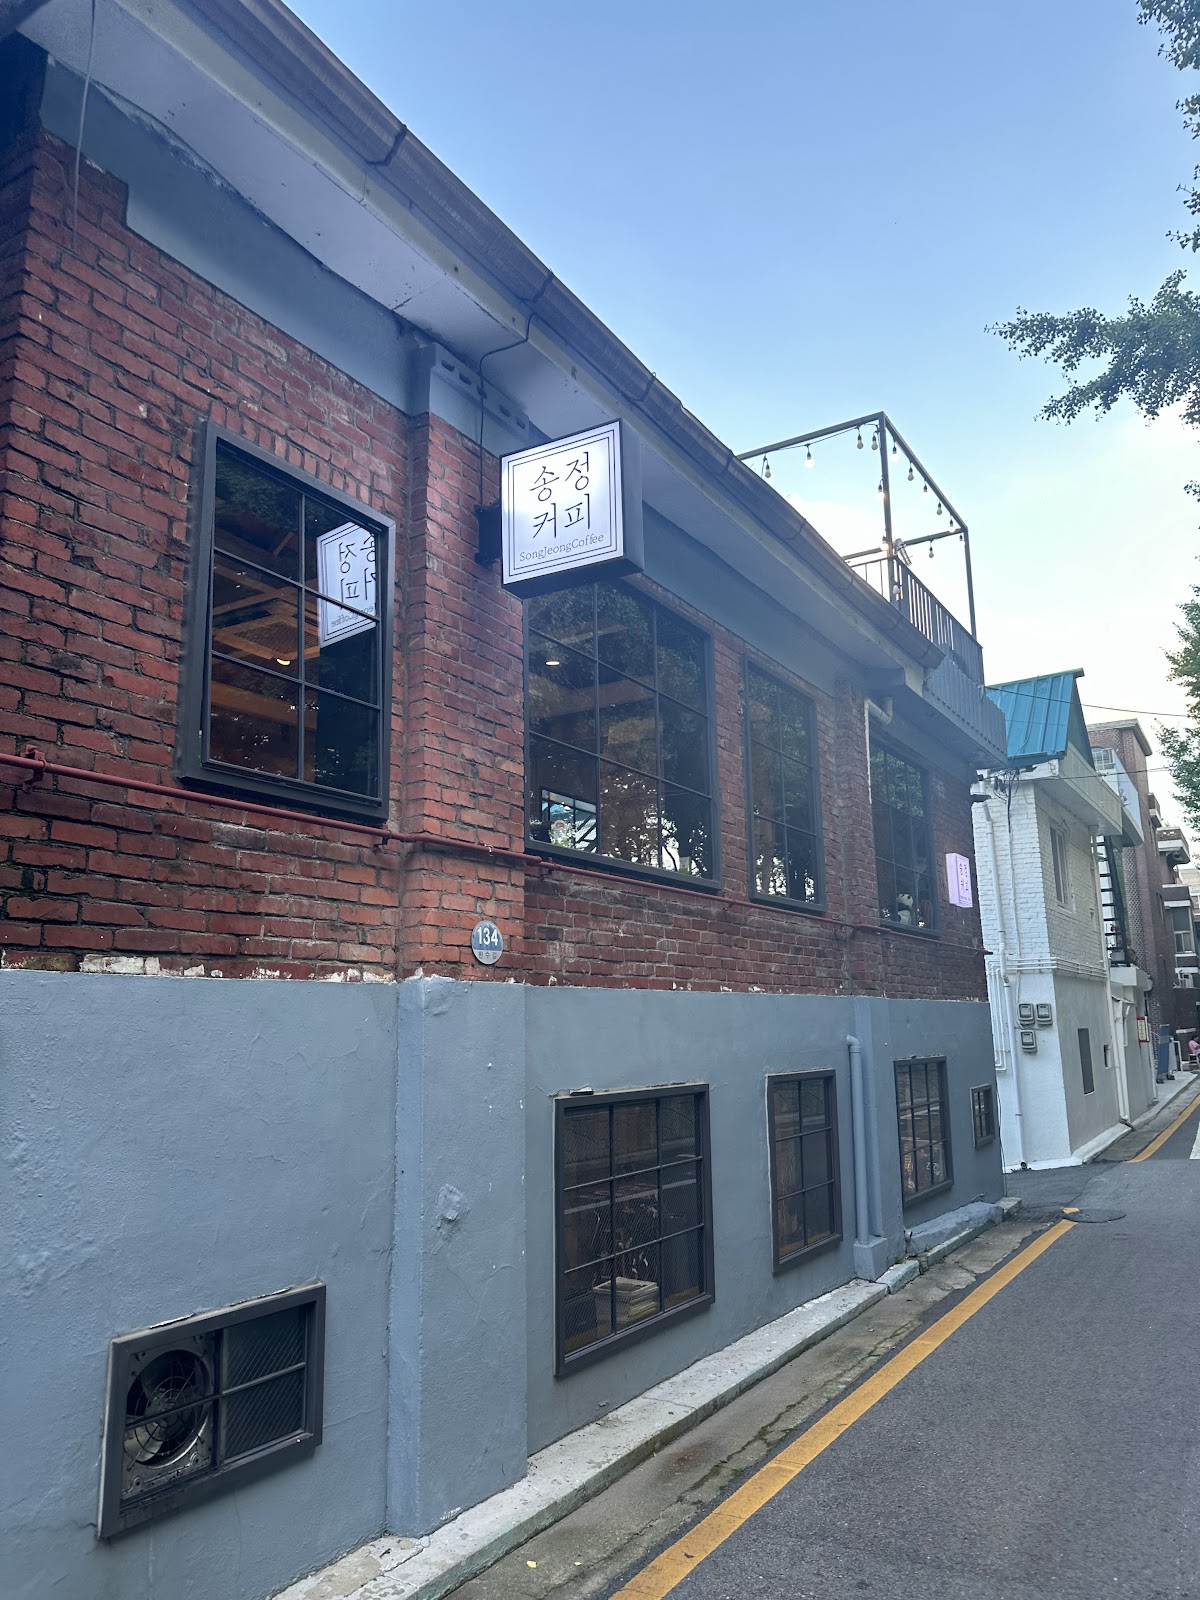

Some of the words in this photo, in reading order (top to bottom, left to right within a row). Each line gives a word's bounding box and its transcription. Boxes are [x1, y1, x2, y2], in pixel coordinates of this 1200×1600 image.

[530, 451, 590, 502] 송정
[532, 493, 591, 539] 커피
[519, 533, 605, 562] SongJeongCoffee
[477, 926, 499, 946] 134
